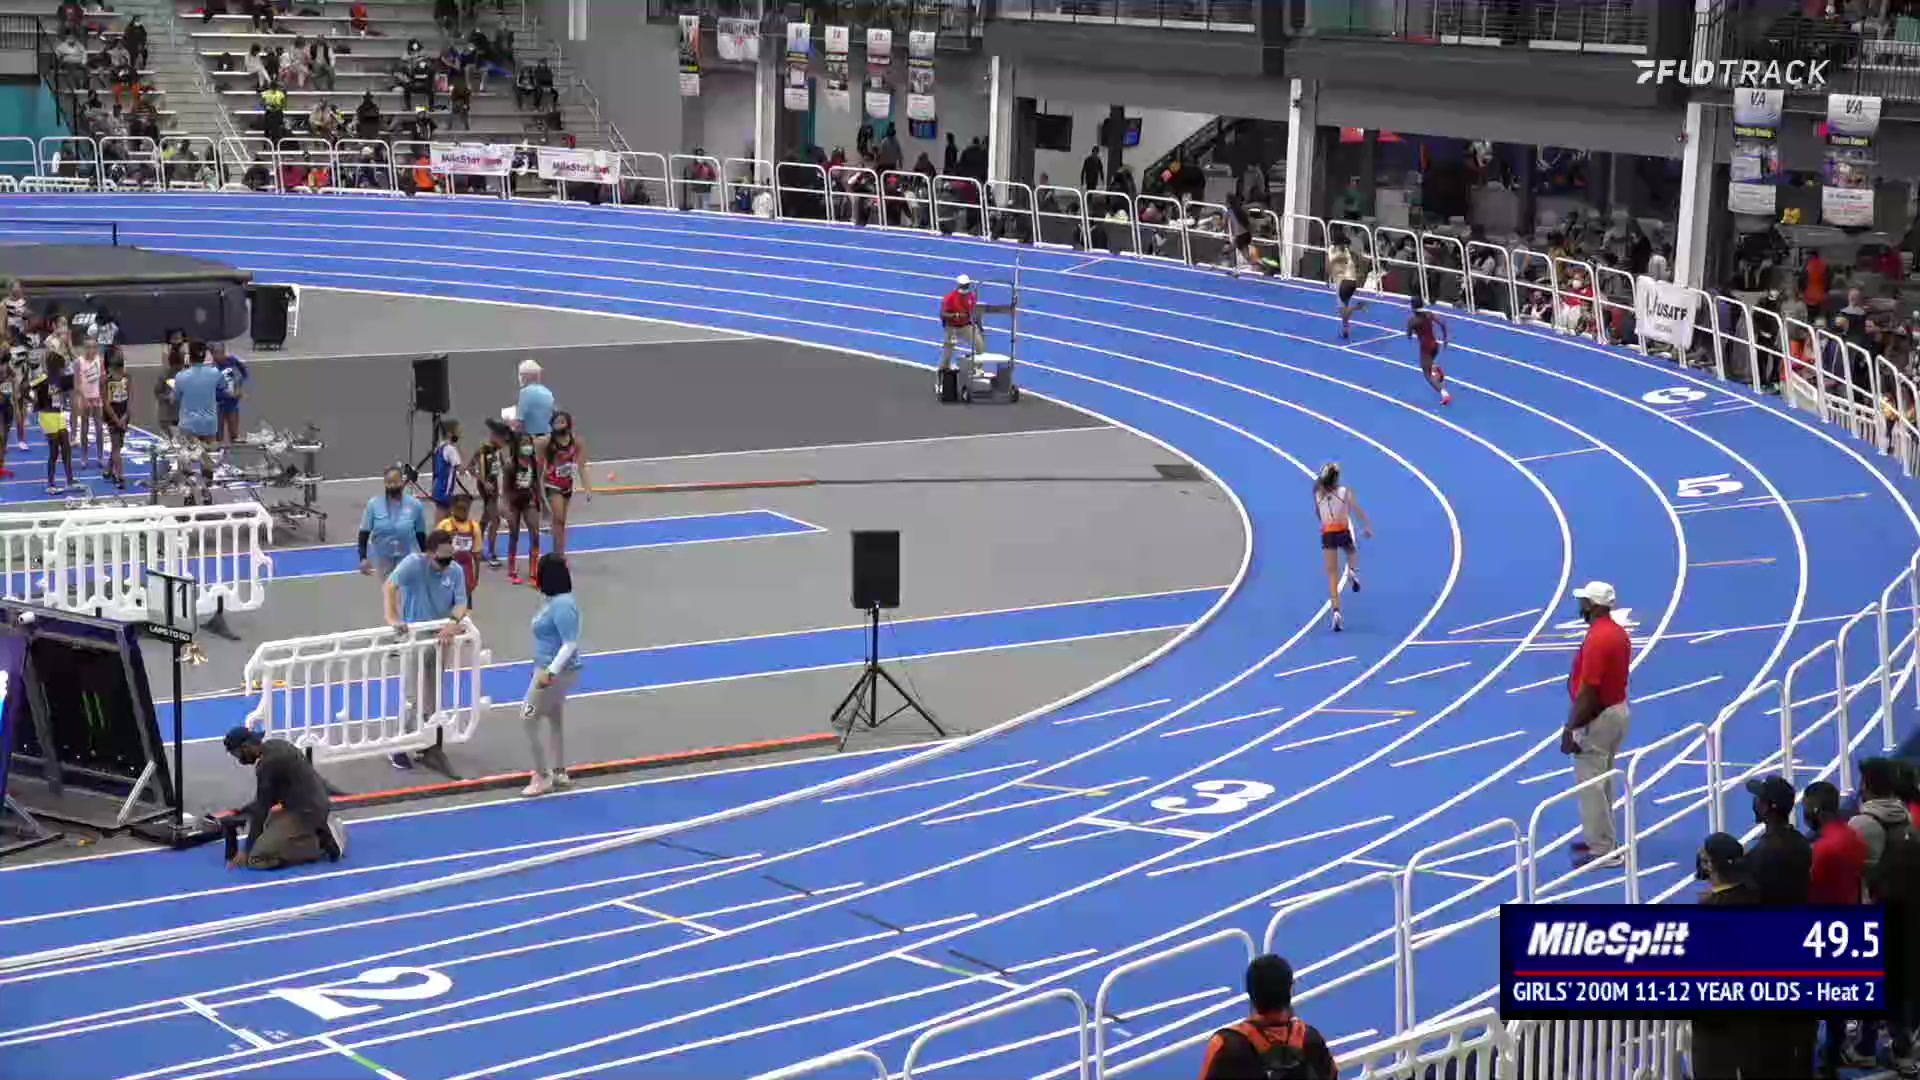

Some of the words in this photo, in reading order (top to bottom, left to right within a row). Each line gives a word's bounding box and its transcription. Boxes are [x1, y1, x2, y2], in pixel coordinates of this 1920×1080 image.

[1642, 387, 1707, 404] 6
[1677, 473, 1744, 497] 5
[176, 583, 187, 619] 1
[1150, 779, 1275, 814] 3
[269, 966, 453, 1020] 2
